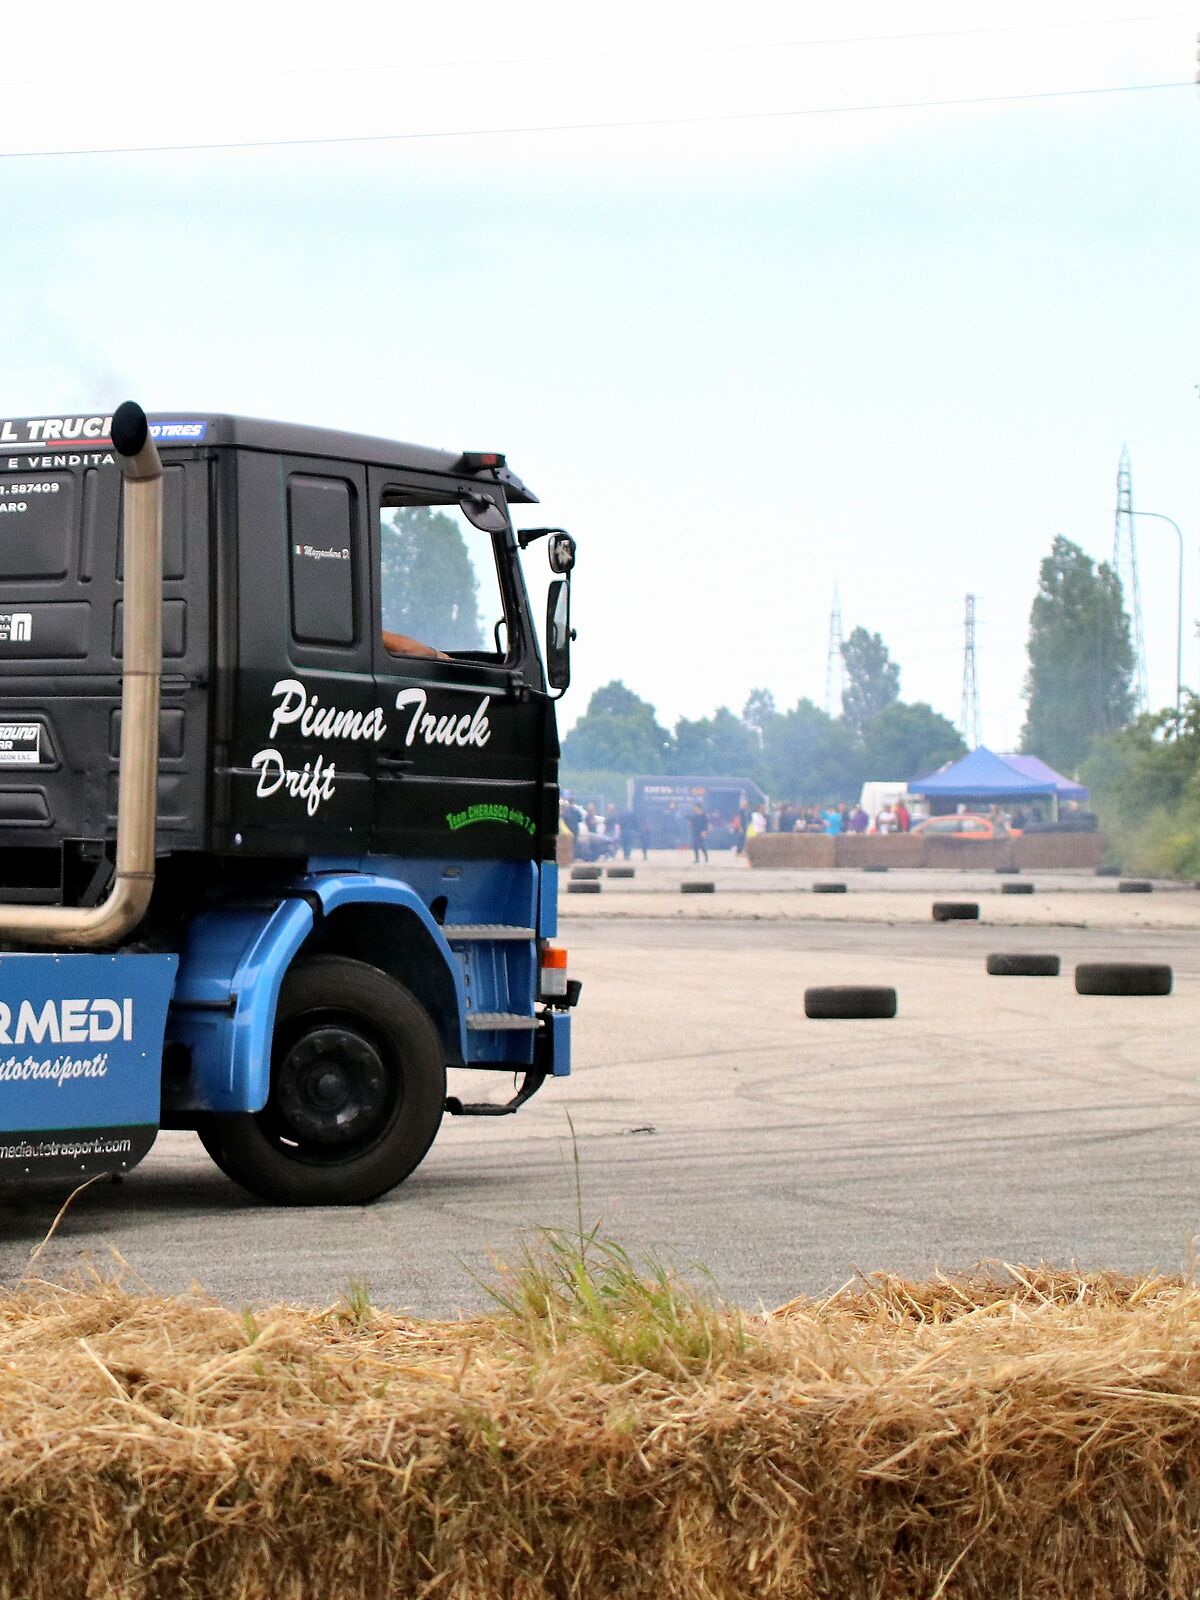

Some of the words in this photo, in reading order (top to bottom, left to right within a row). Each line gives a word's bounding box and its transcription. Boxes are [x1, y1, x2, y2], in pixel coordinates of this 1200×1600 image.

[161, 424, 203, 436] TIRES
[8, 458, 18, 468] E
[28, 453, 115, 468] VENDITA
[269, 679, 387, 742] Piuma
[396, 687, 492, 747] Truck
[251, 748, 336, 816] Drift
